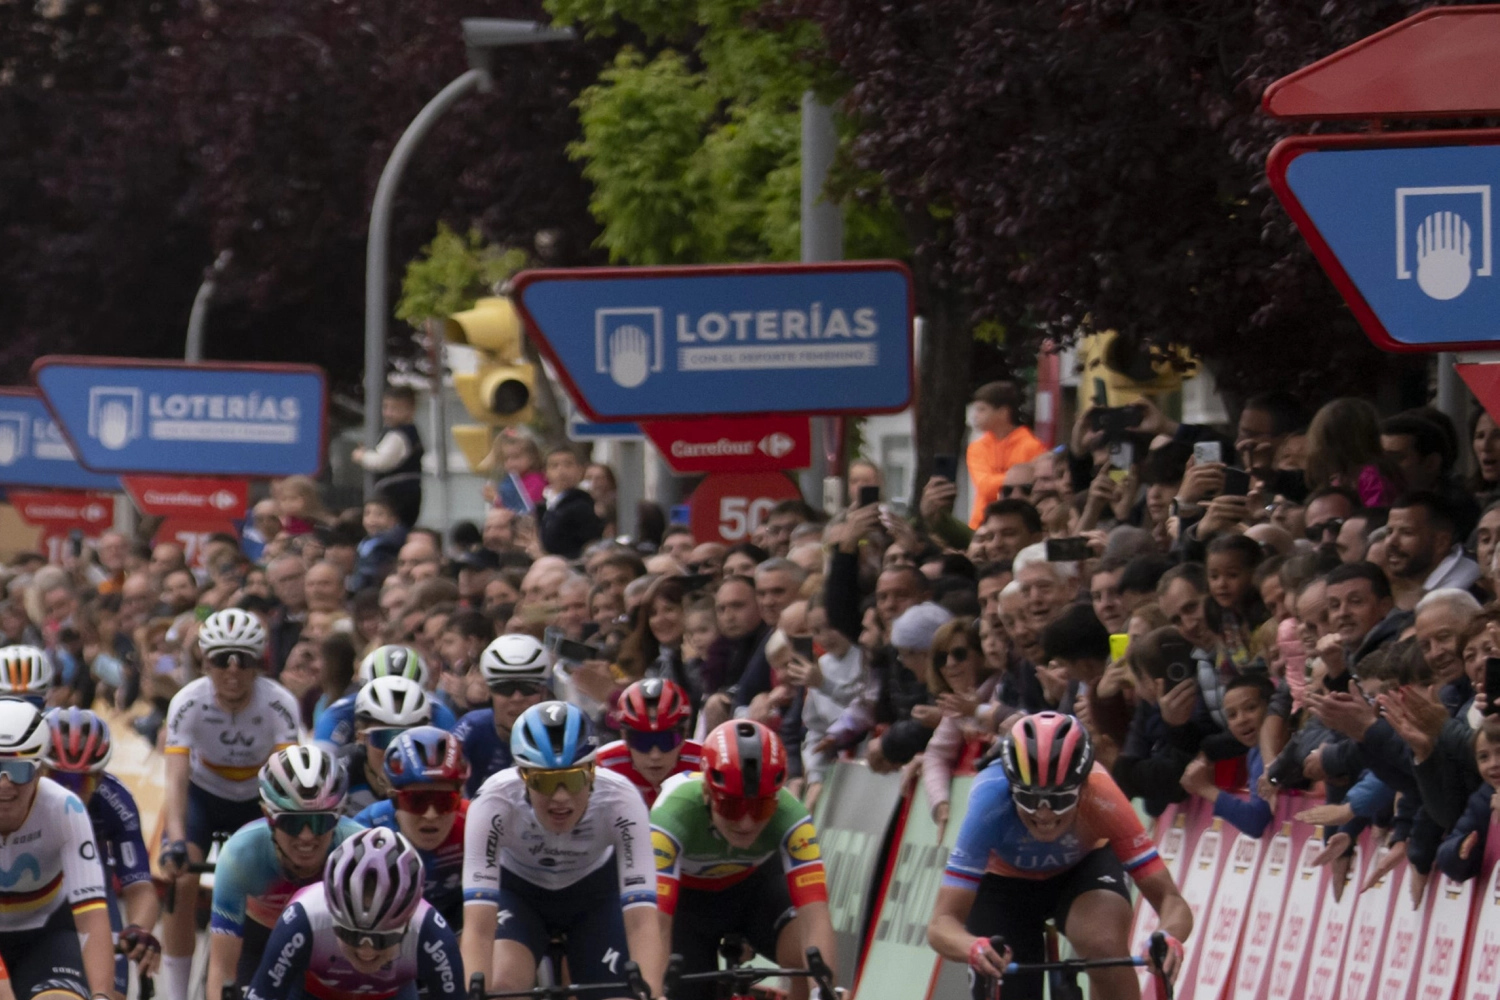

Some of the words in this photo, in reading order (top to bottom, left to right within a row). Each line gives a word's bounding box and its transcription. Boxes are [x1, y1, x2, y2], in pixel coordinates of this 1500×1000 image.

[676, 302, 878, 342] LOTERÍAS
[149, 390, 297, 420] LOTERÍAS
[671, 438, 754, 458] Carrefour
[715, 730, 729, 765] TREK
[267, 932, 305, 988] Jayco
[423, 939, 455, 993] Jayco
